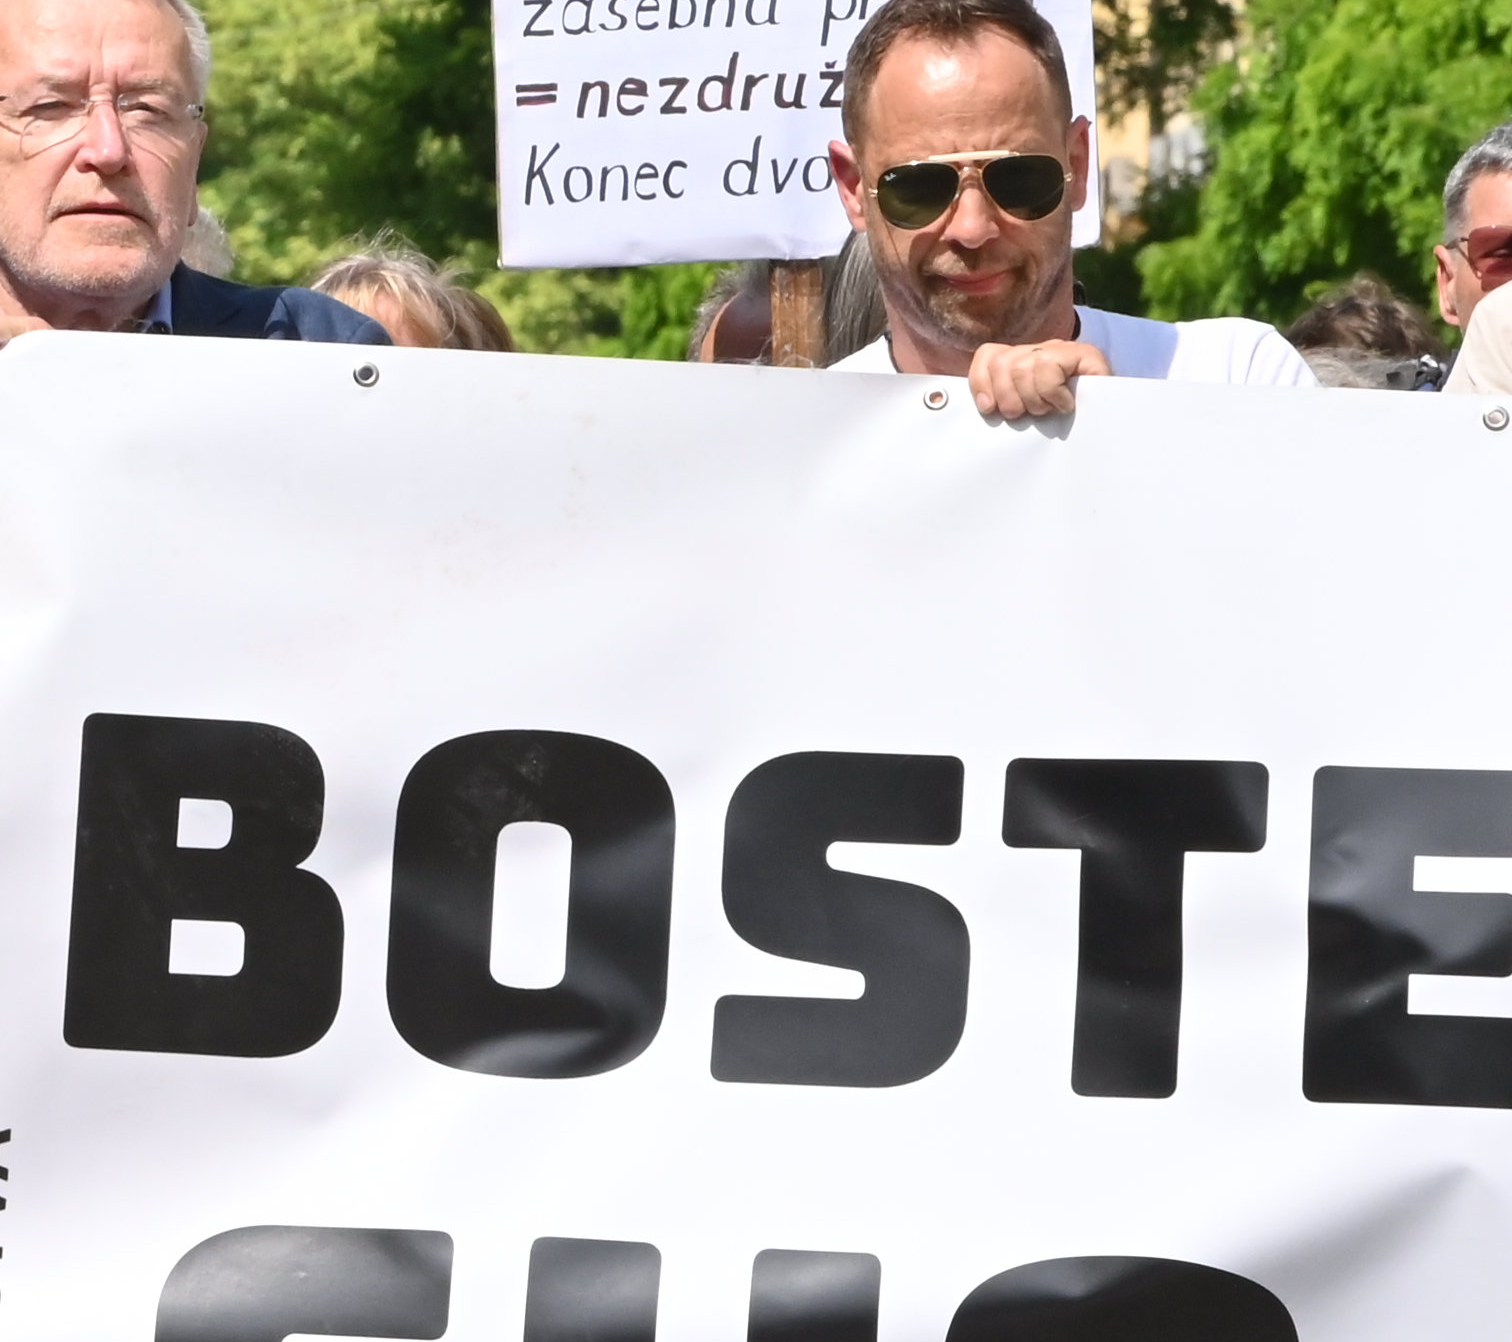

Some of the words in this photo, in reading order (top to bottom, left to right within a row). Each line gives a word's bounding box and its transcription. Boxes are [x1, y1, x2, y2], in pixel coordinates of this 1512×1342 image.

[576, 51, 846, 114] nezdruž
[524, 142, 688, 206] Konec
[723, 135, 833, 197] dvo
[63, 712, 1512, 1110] BOSTE
